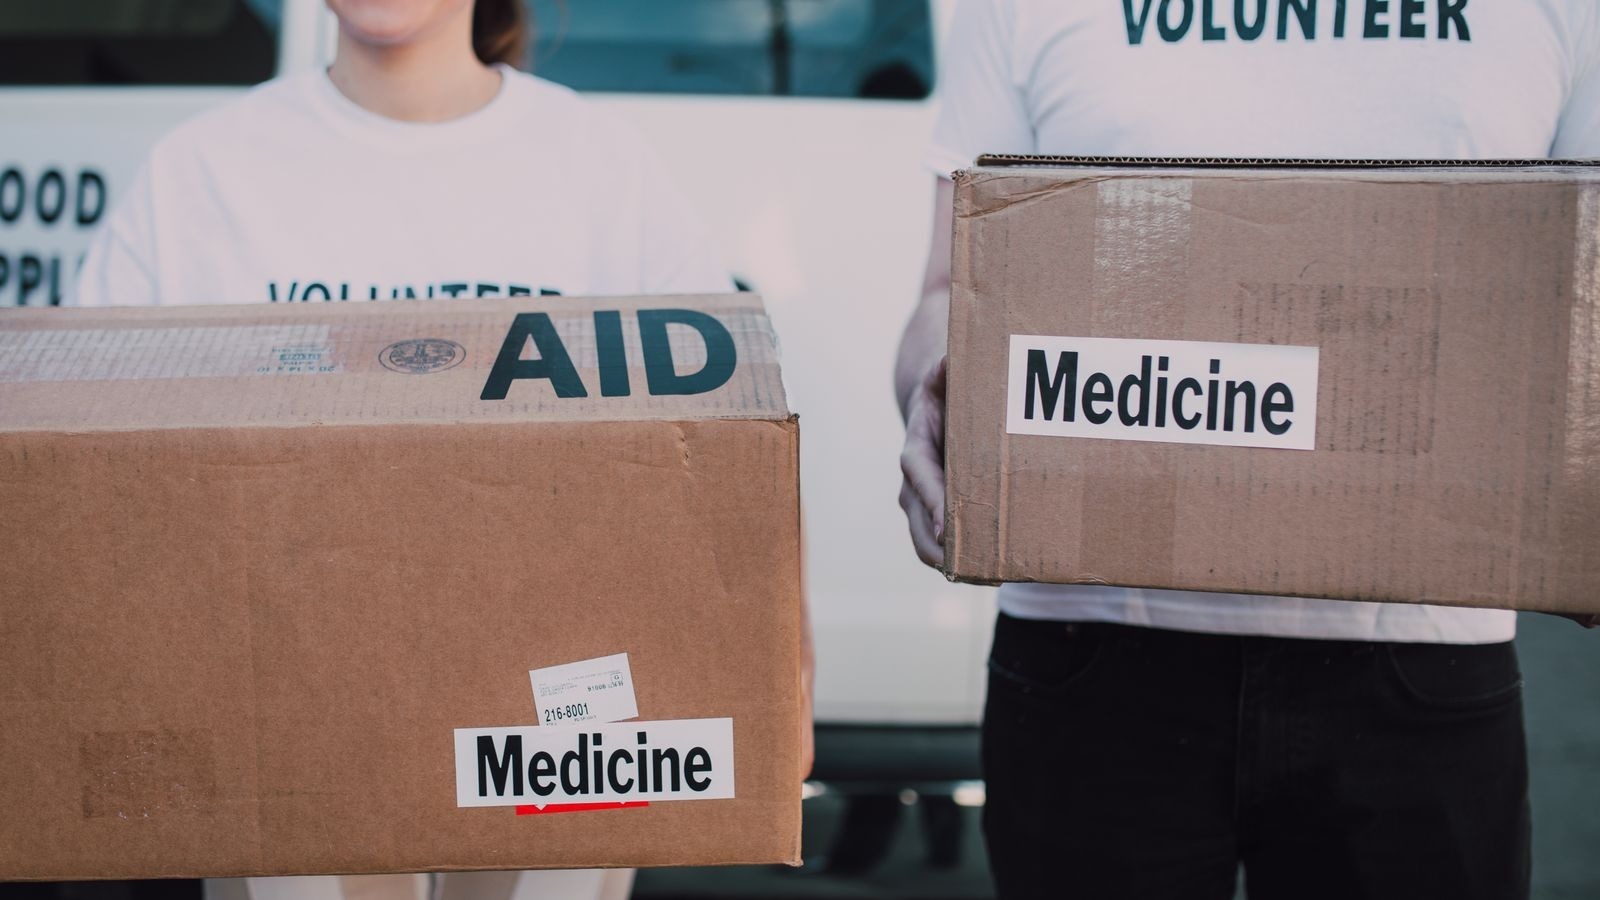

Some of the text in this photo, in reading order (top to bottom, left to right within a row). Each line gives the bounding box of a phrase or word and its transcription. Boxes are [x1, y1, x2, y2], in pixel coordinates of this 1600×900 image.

[1121, 0, 1472, 45] VOLUNTEER
[480, 308, 737, 401] AID
[1023, 348, 1295, 436] Medicine
[544, 702, 589, 722] 216-8001
[476, 731, 713, 797] Medicine
